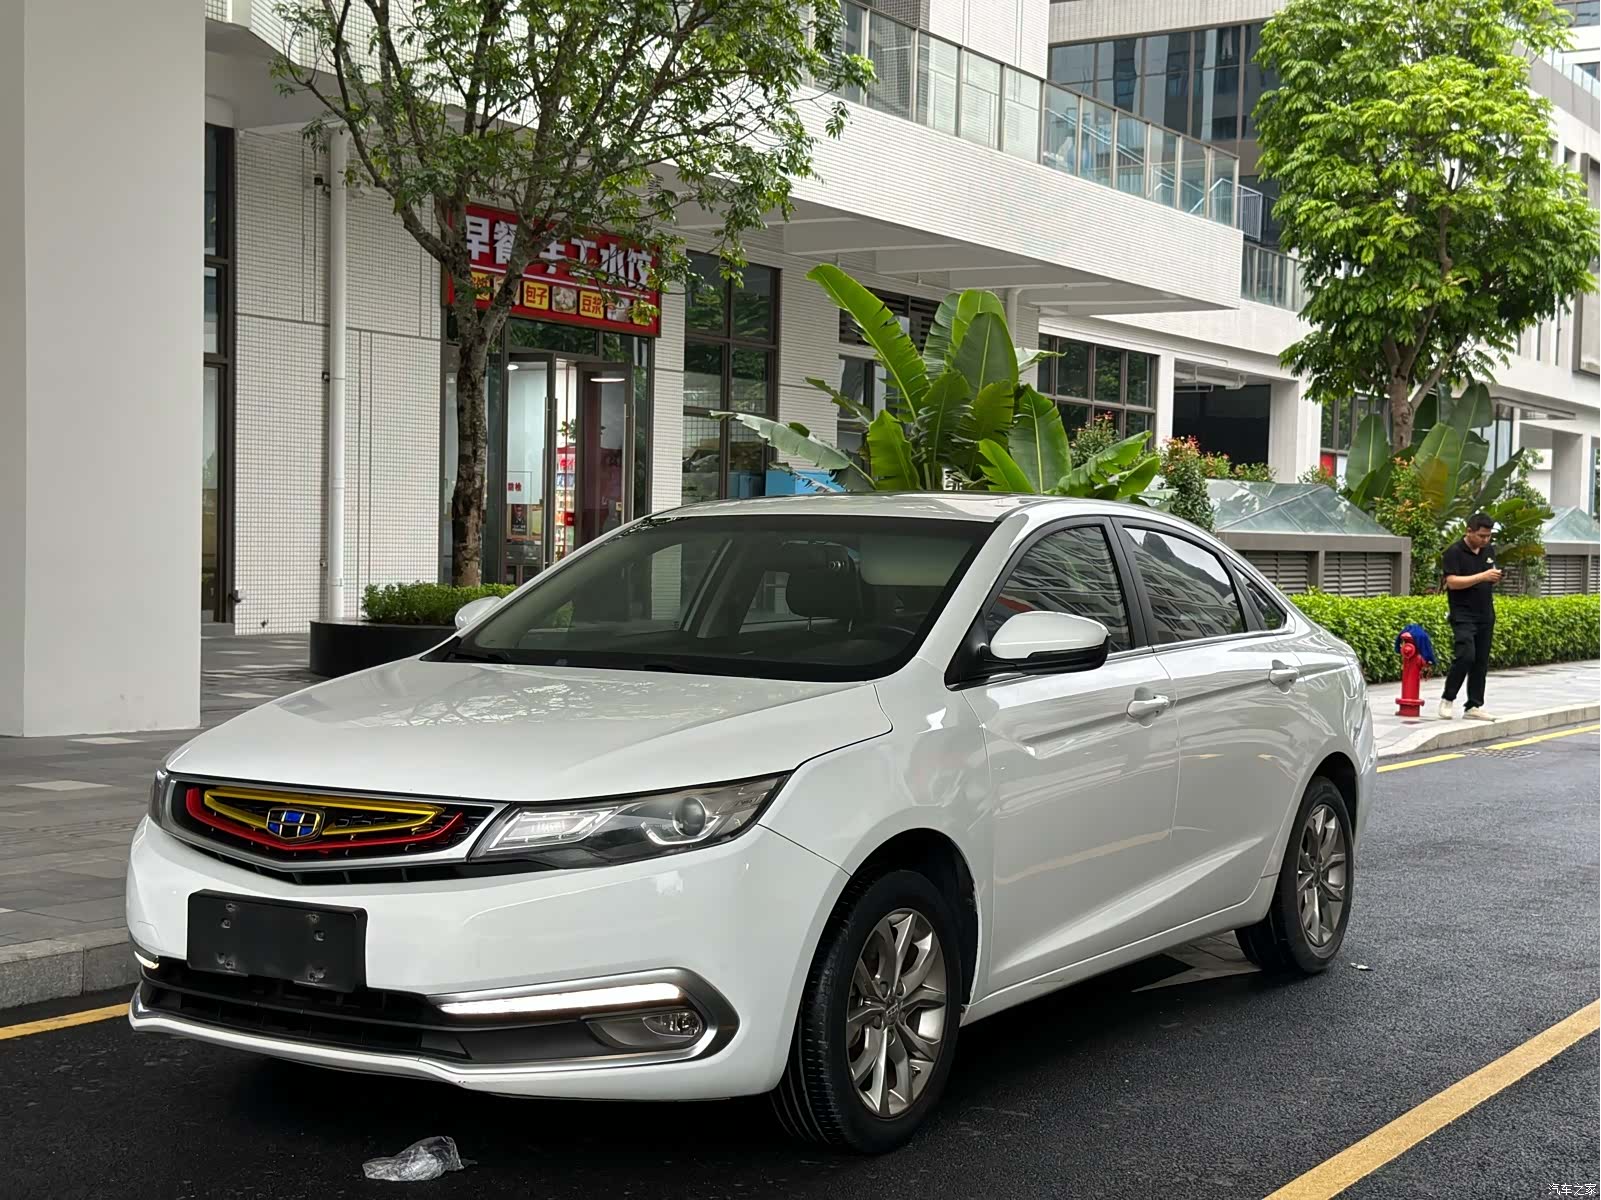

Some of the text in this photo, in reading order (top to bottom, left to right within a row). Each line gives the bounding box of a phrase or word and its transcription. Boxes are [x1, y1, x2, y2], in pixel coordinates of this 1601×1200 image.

[465, 215, 518, 264] 早餐
[525, 284, 548, 304] 包子
[581, 295, 603, 316] 豆浆
